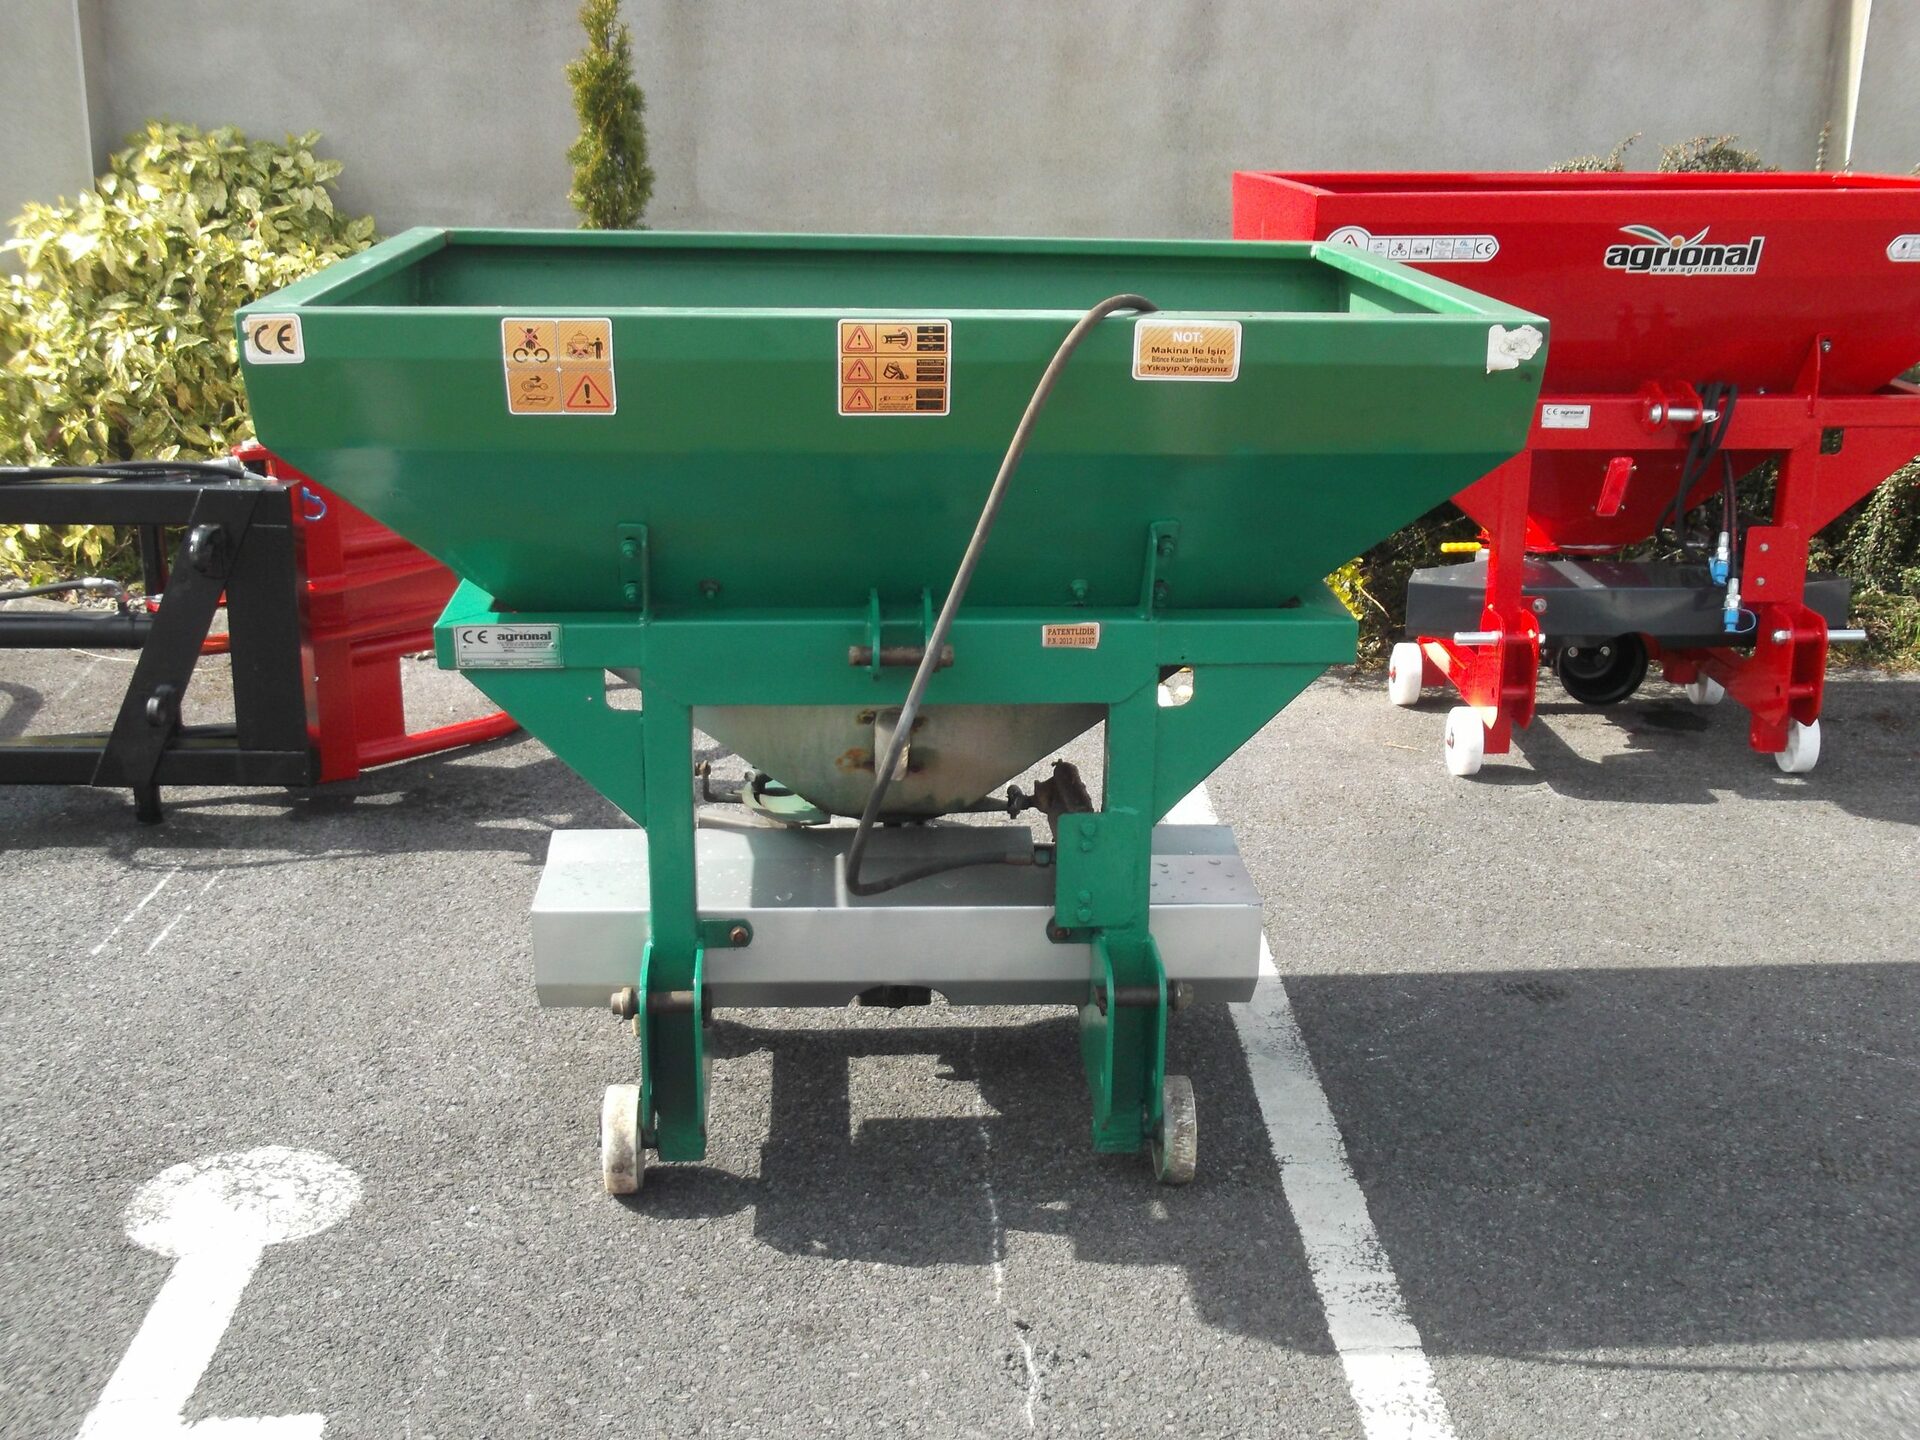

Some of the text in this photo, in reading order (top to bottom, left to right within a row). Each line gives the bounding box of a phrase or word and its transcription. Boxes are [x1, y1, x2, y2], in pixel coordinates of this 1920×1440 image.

[1475, 242, 1493, 255] CE
[1606, 238, 1762, 271] agrional
[254, 323, 296, 355] CE
[1173, 331, 1203, 343] NOT:
[1151, 346, 1189, 355] Makina
[1207, 346, 1227, 356] İşin
[1147, 364, 1228, 373] Yıkayıp Yağlayınız
[462, 630, 552, 644] CE agrional
[1059, 637, 1072, 645] 2012
